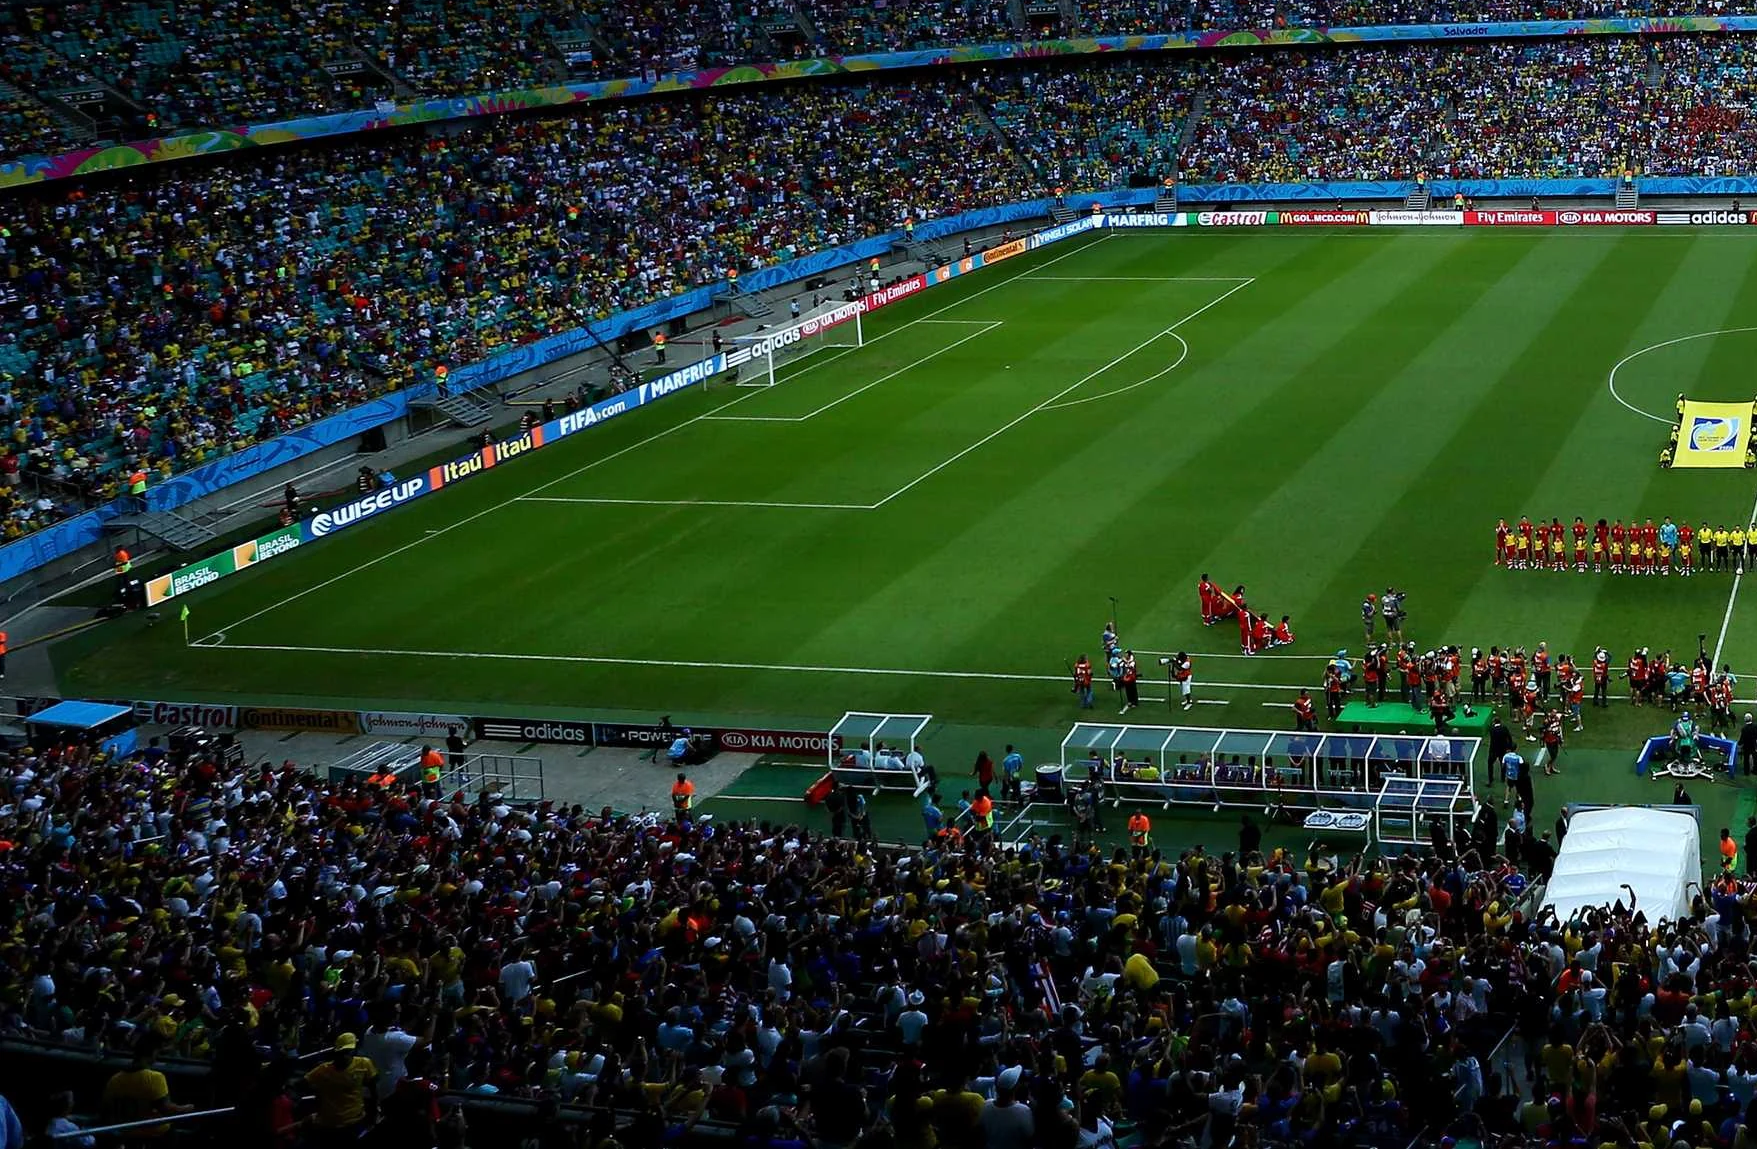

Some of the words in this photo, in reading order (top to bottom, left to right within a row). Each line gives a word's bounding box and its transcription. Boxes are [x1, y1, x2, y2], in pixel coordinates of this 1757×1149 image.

[1443, 26, 1489, 36] Salvador
[1108, 214, 1168, 227] MARFRIG
[1211, 212, 1263, 226] Castrol
[1478, 212, 1496, 224] Fly
[1497, 212, 1543, 222] Emirates
[1582, 213, 1604, 222] KIA
[1604, 213, 1652, 222] MOTORS
[1691, 211, 1748, 224] adidas
[983, 242, 1018, 264] Continental
[873, 292, 887, 306] Fly
[887, 278, 921, 301] Emirates
[751, 328, 801, 357] adidas
[651, 357, 714, 398] MARFRIG
[496, 432, 532, 462] Itaú
[444, 452, 482, 483] Itaú
[259, 533, 293, 554] BRASIL
[260, 538, 300, 562] BEYOND
[174, 566, 213, 587] BRASIL
[175, 571, 220, 596] BEYOND
[155, 703, 233, 727] Castrol
[243, 710, 341, 731] Continental
[523, 723, 585, 742] adidas
[751, 735, 776, 747] KIA
[778, 736, 840, 751] MOTORS
